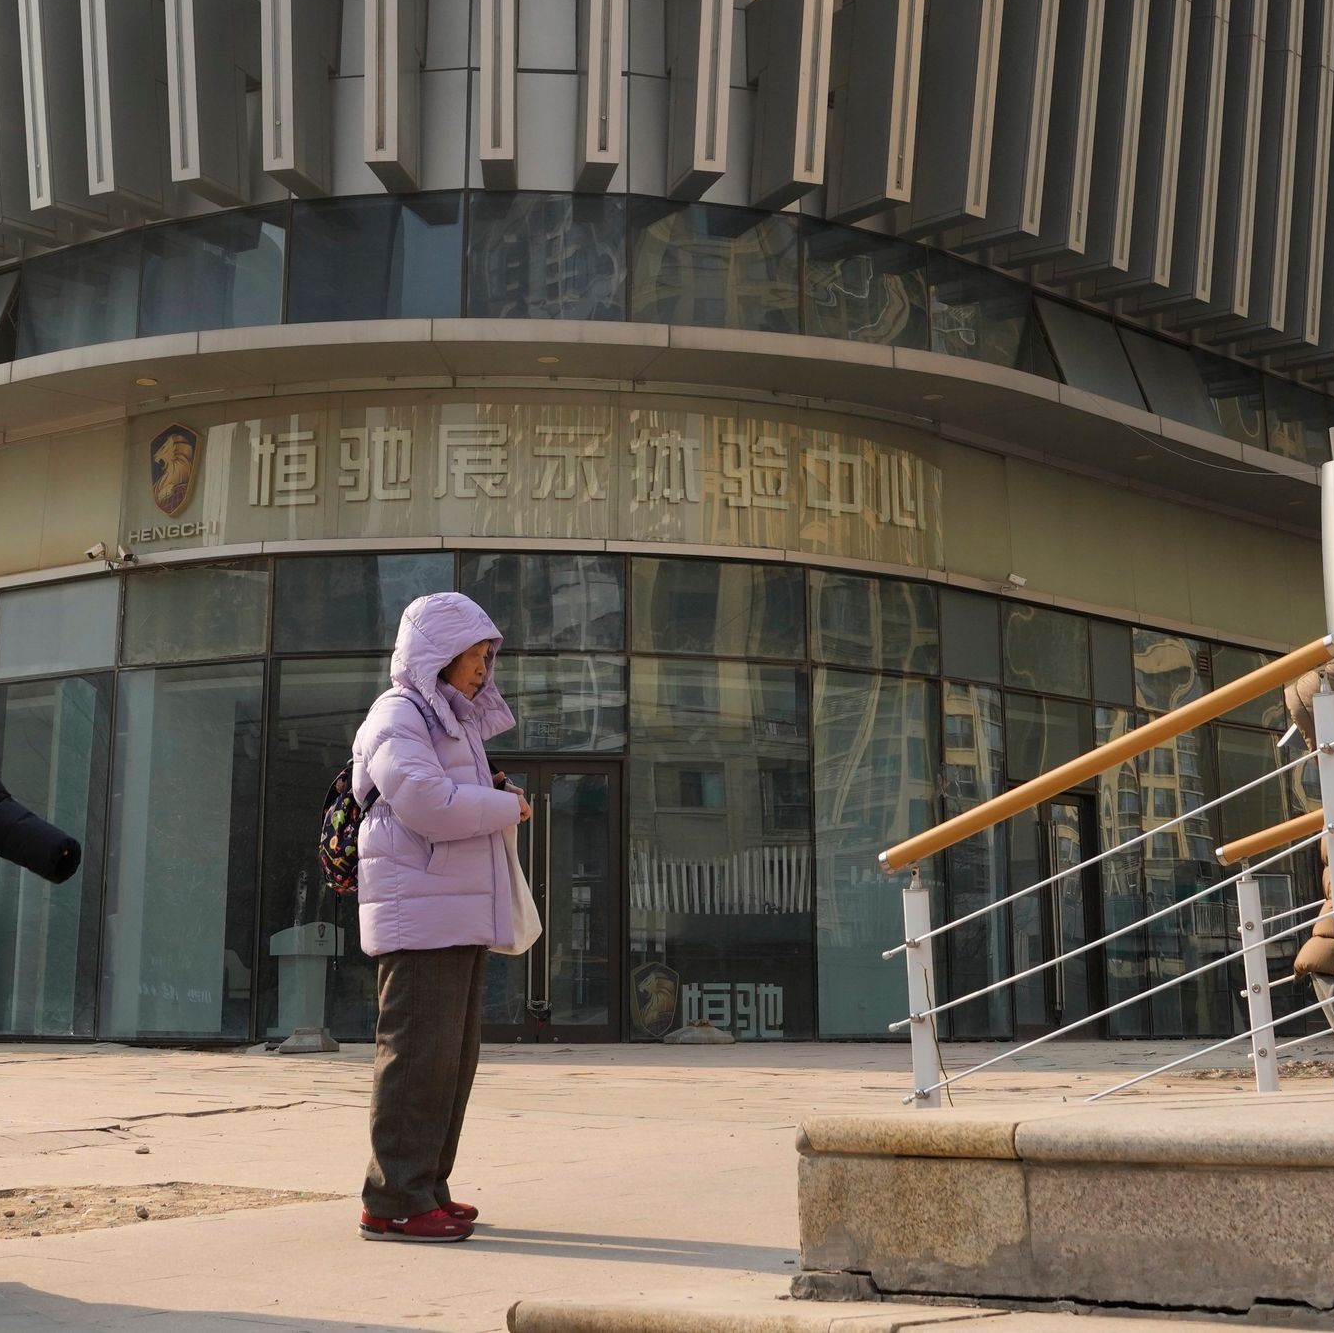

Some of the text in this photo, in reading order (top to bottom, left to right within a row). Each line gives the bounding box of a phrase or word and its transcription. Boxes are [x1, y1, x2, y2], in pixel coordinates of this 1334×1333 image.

[249, 424, 927, 531] 恒驰展示体验中心
[128, 521, 217, 543] HENGCHI
[682, 982, 784, 1037] 恒驰
